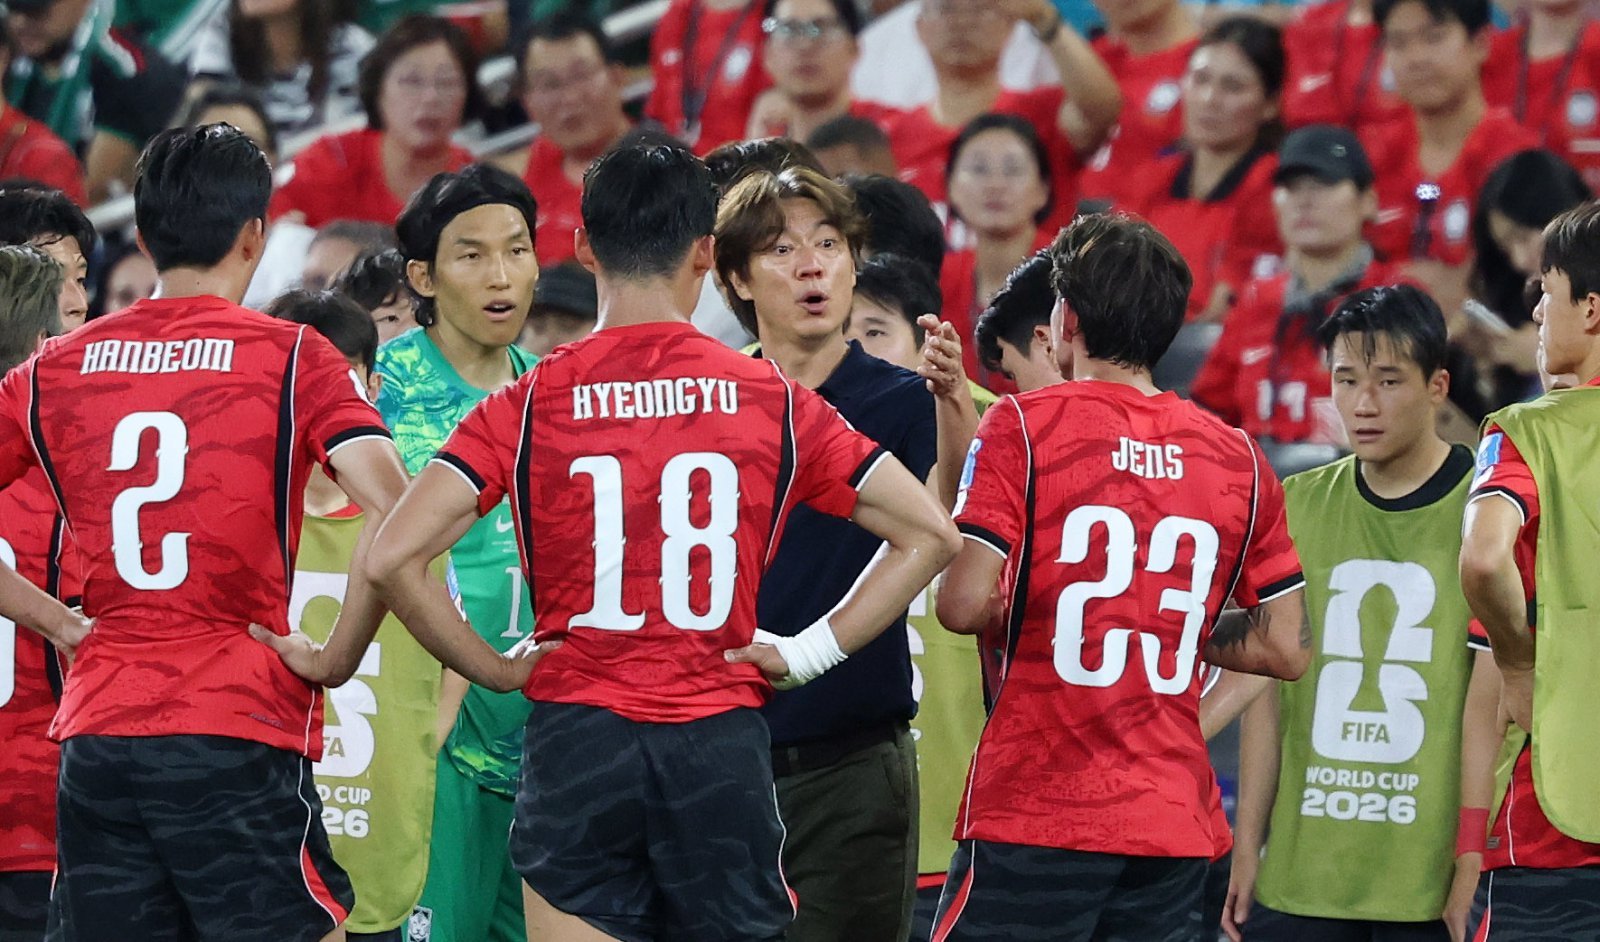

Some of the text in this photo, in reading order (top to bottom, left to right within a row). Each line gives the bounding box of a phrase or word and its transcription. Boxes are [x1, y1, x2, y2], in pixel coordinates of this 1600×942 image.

[80, 338, 235, 375] HANBEOM
[572, 377, 739, 420] HYEONGYU
[1111, 436, 1184, 480] JENS
[106, 411, 192, 591] 2
[568, 452, 740, 632] 18
[1052, 505, 1220, 695] 23
[1341, 721, 1391, 744] FIFA
[334, 785, 371, 805] CUP
[1305, 765, 1420, 792] WORLD CUP
[321, 806, 369, 838] 26
[1301, 787, 1417, 825] 2026
